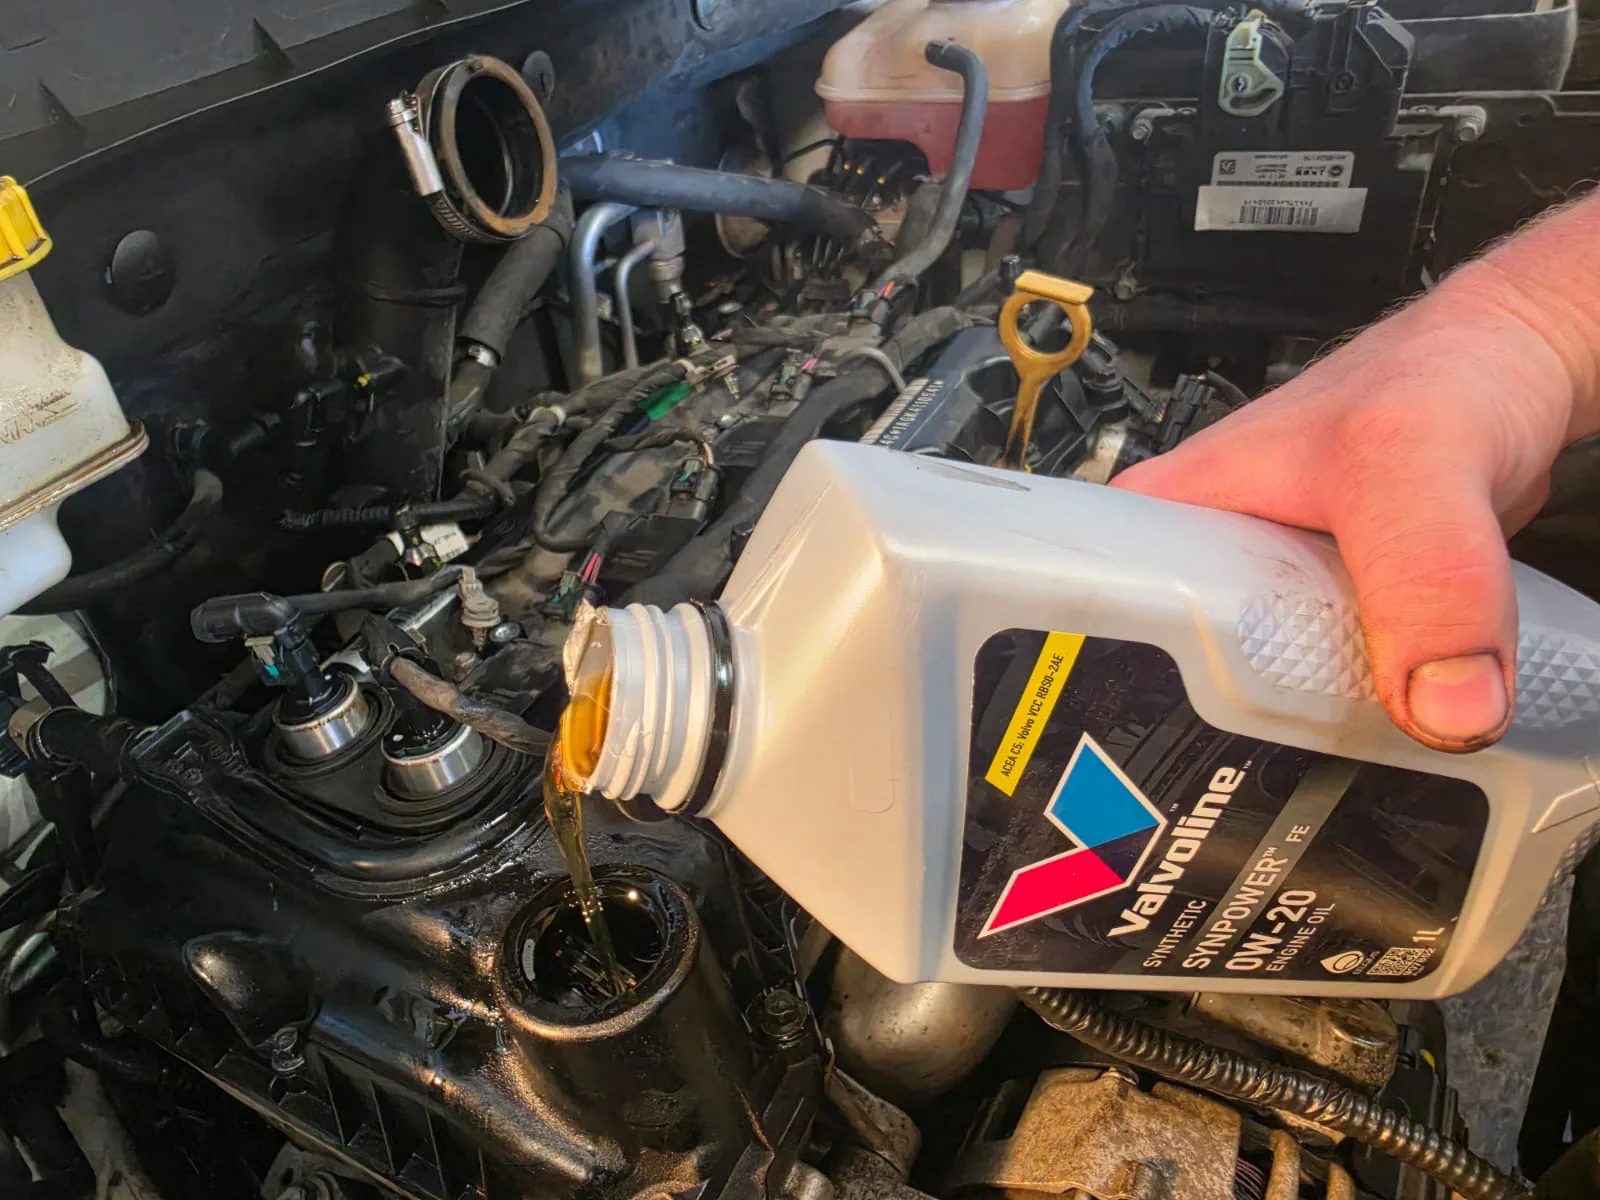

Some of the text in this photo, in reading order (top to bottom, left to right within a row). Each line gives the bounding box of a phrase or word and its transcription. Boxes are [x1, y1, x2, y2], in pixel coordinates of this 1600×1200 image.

[1027, 700, 1043, 717] VCC
[1017, 718, 1035, 741] Volvo
[1011, 741, 1024, 755] C5:
[1001, 756, 1018, 777] ACEA
[1285, 824, 1311, 843] FE
[1142, 899, 1207, 969] SYNTHETIC
[1225, 889, 1317, 971] 0W-20
[1265, 903, 1336, 972] ENGINE OIL
[1412, 927, 1445, 943] 1L
